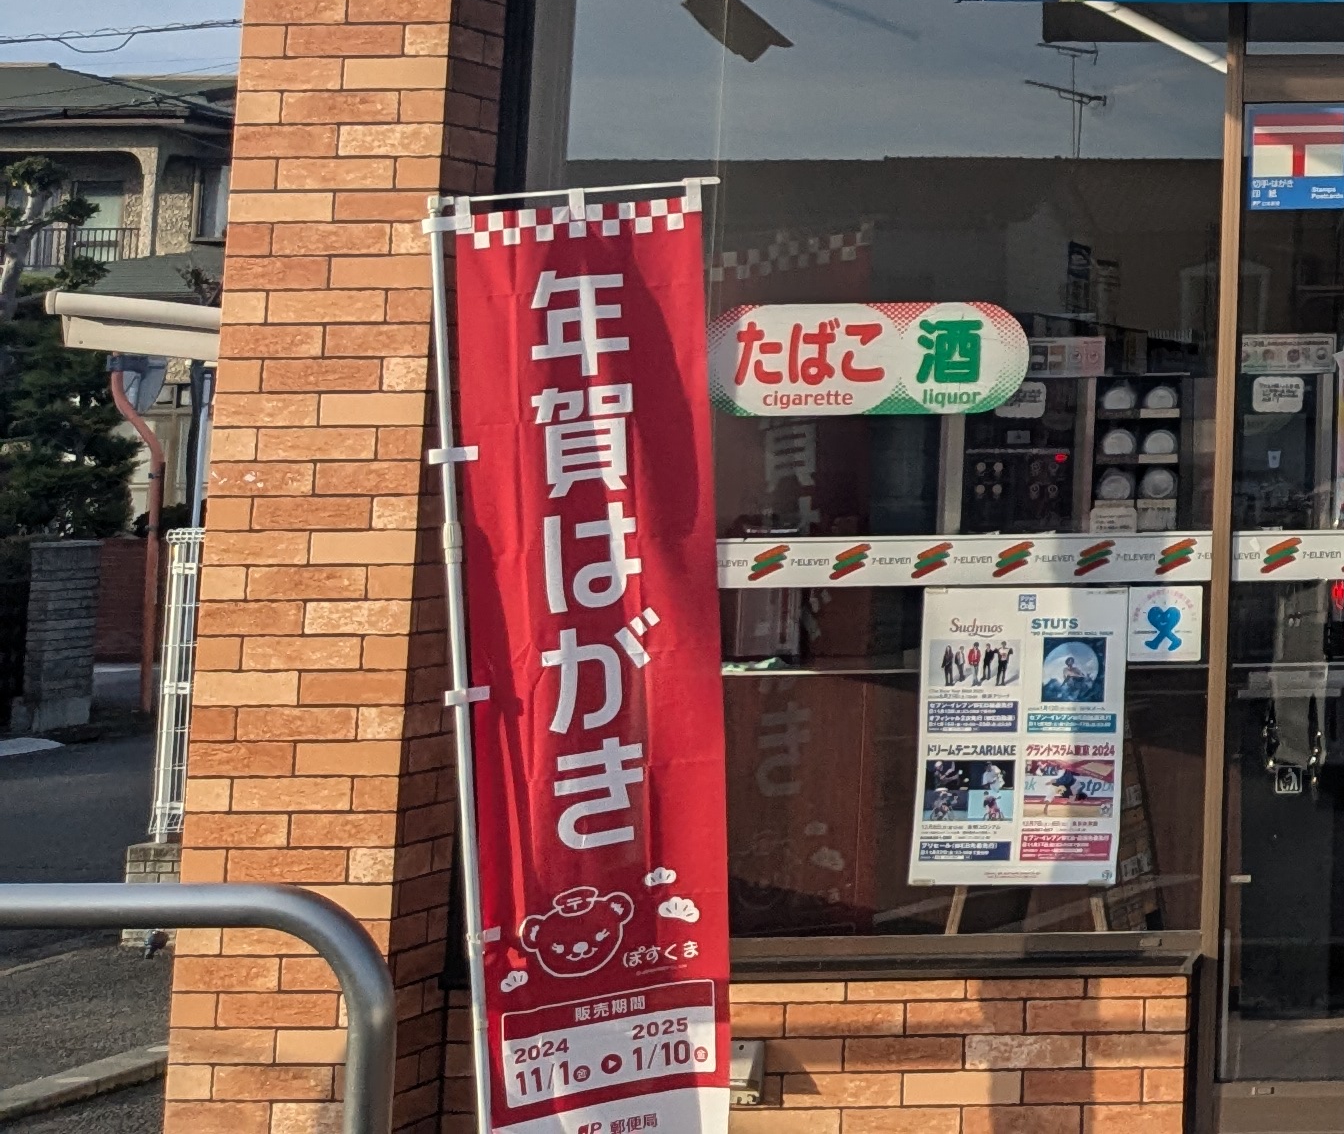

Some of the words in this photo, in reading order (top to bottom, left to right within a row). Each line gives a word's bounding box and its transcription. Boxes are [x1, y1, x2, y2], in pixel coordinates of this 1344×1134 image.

[735, 317, 886, 385] たばこ
[916, 319, 983, 384] 酒
[762, 387, 854, 409] cigarette
[922, 387, 981, 407] liquor
[531, 270, 660, 849] 年賀はがき
[1031, 618, 1079, 630] STUTS
[575, 996, 646, 1022] 販売期間
[631, 1017, 689, 1040] 2025
[514, 1038, 570, 1064] 2024
[610, 1113, 658, 1134] 郵便局
